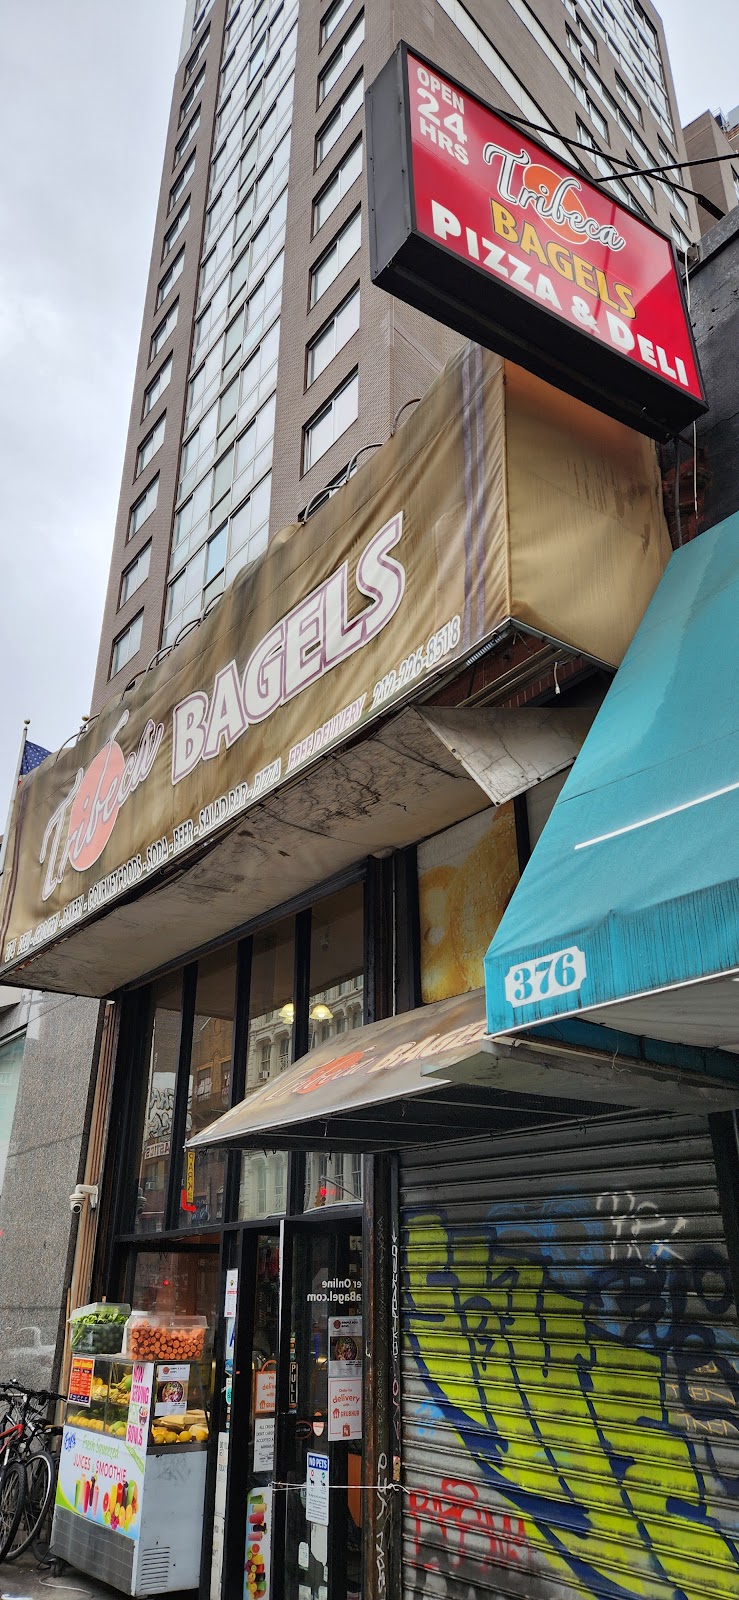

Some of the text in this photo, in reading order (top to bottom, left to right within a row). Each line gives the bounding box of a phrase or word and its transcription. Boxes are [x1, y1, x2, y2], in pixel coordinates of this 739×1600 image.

[417, 67, 464, 115] OPEN
[417, 88, 467, 144] 24
[420, 116, 469, 165] HRS
[483, 142, 626, 252] Tribeca
[490, 198, 637, 320] BAGELS
[431, 200, 689, 387] PIZZA & DELI
[40, 511, 406, 901] Tribeca BAGELS
[88, 869, 119, 911] GOURMET
[118, 853, 142, 892] FOODS
[147, 836, 168, 872] SODA
[173, 819, 194, 854] BEER
[199, 795, 228, 836] SALAD
[228, 782, 248, 815] BAR
[285, 733, 314, 775] FREE
[312, 692, 367, 755] DELIVERY
[368, 615, 461, 712] 212-226-8518
[514, 953, 576, 1000] 376
[131, 1384, 149, 1404] SERVING
[133, 1365, 145, 1384] NOW
[332, 1394, 360, 1404] delivery
[82, 1435, 95, 1452] Fresh
[96, 1439, 119, 1459] Squeezed
[127, 1424, 143, 1446] BOWLS
[73, 1454, 91, 1471] JUICES
[95, 1460, 127, 1483] SMOOTHIE
[309, 1456, 328, 1469] NO PETS
